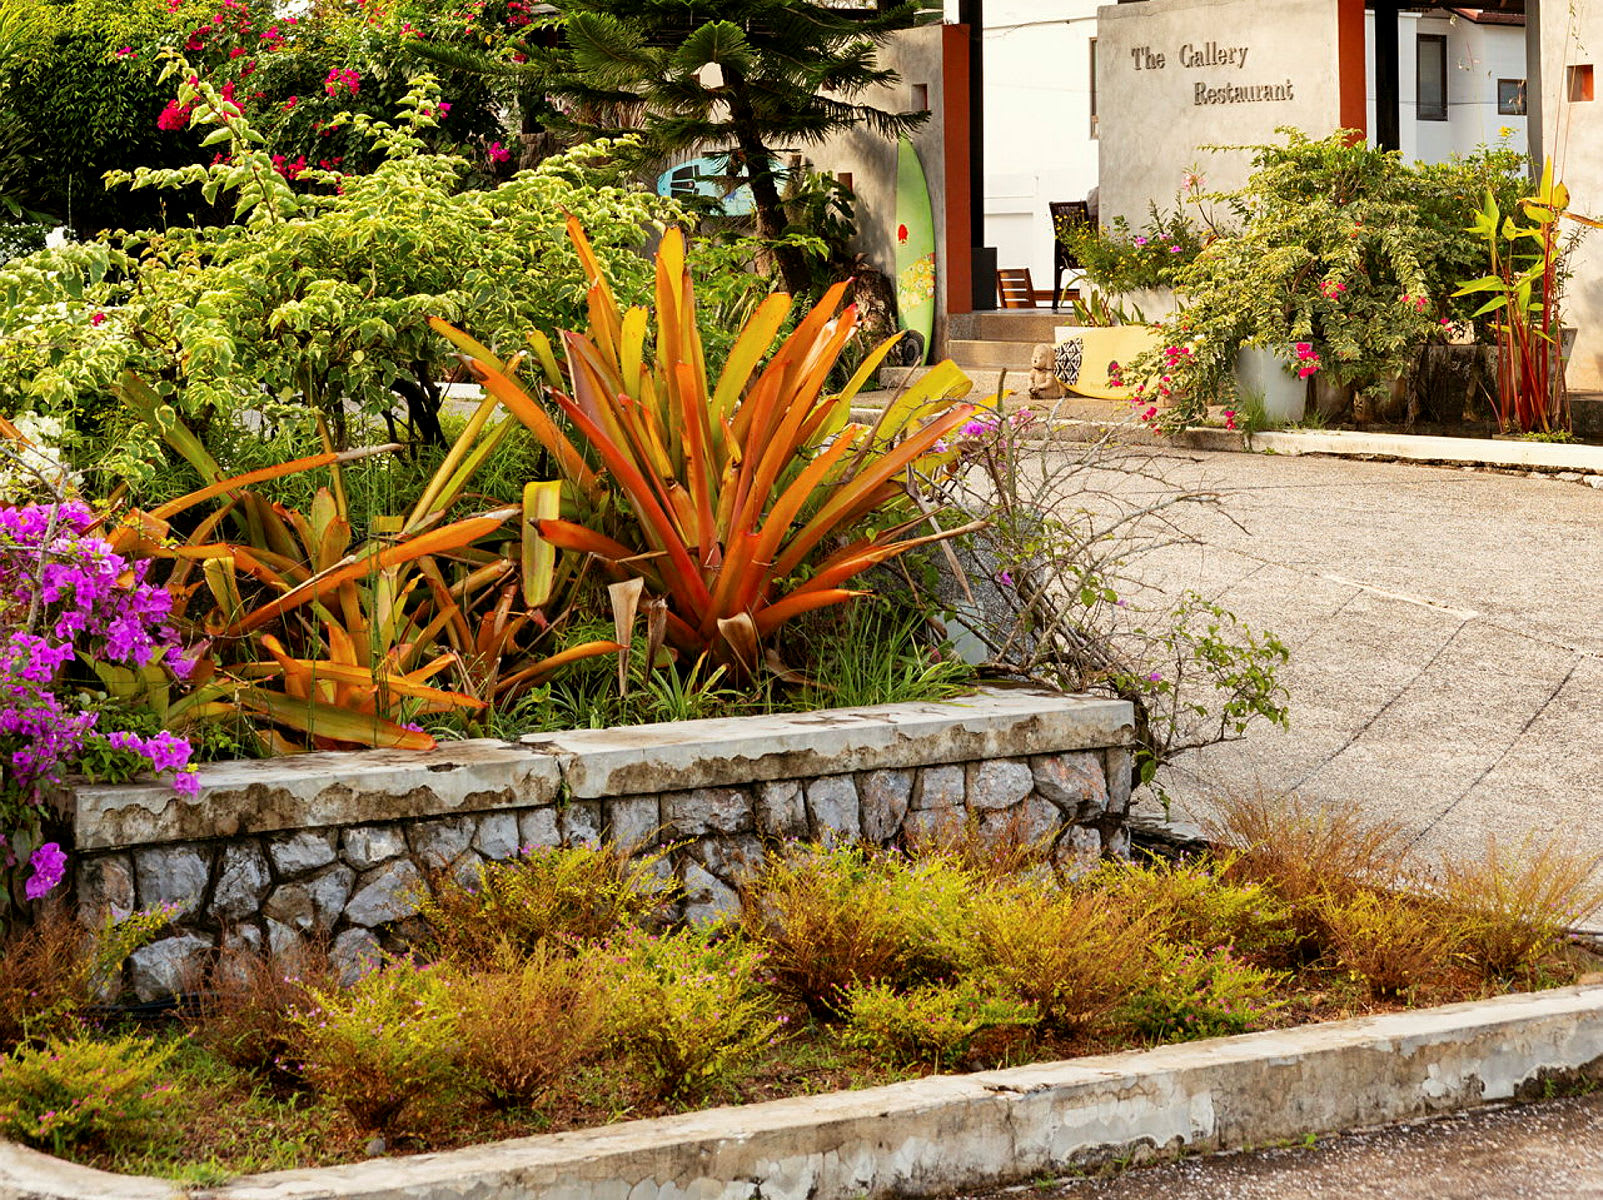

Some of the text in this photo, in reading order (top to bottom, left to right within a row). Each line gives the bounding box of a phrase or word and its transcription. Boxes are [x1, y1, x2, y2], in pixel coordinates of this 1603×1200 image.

[1131, 41, 1249, 71] The Gallery
[1193, 79, 1294, 106] Restaurant
